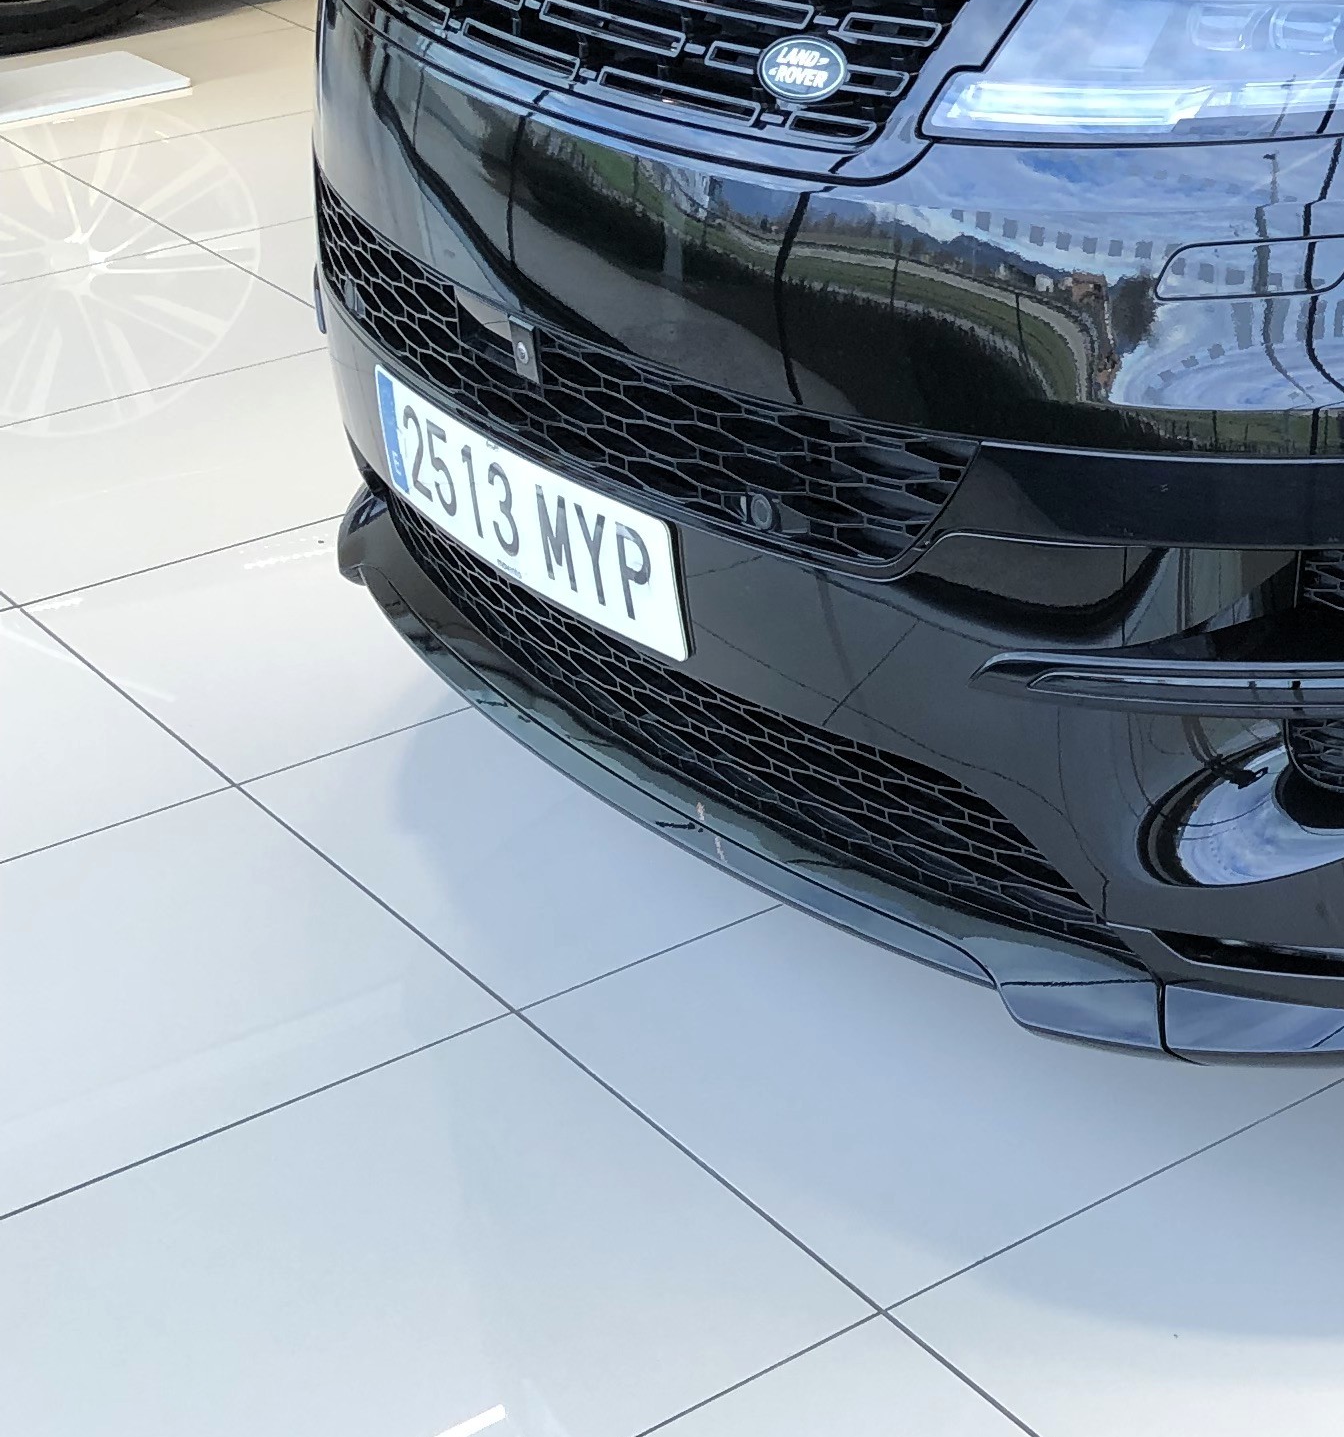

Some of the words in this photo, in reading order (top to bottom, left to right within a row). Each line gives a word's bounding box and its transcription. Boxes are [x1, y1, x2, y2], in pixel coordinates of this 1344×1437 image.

[775, 46, 820, 68] LAND
[774, 64, 829, 89] ROVER
[402, 404, 520, 557] 2513
[535, 483, 652, 621] MYP
